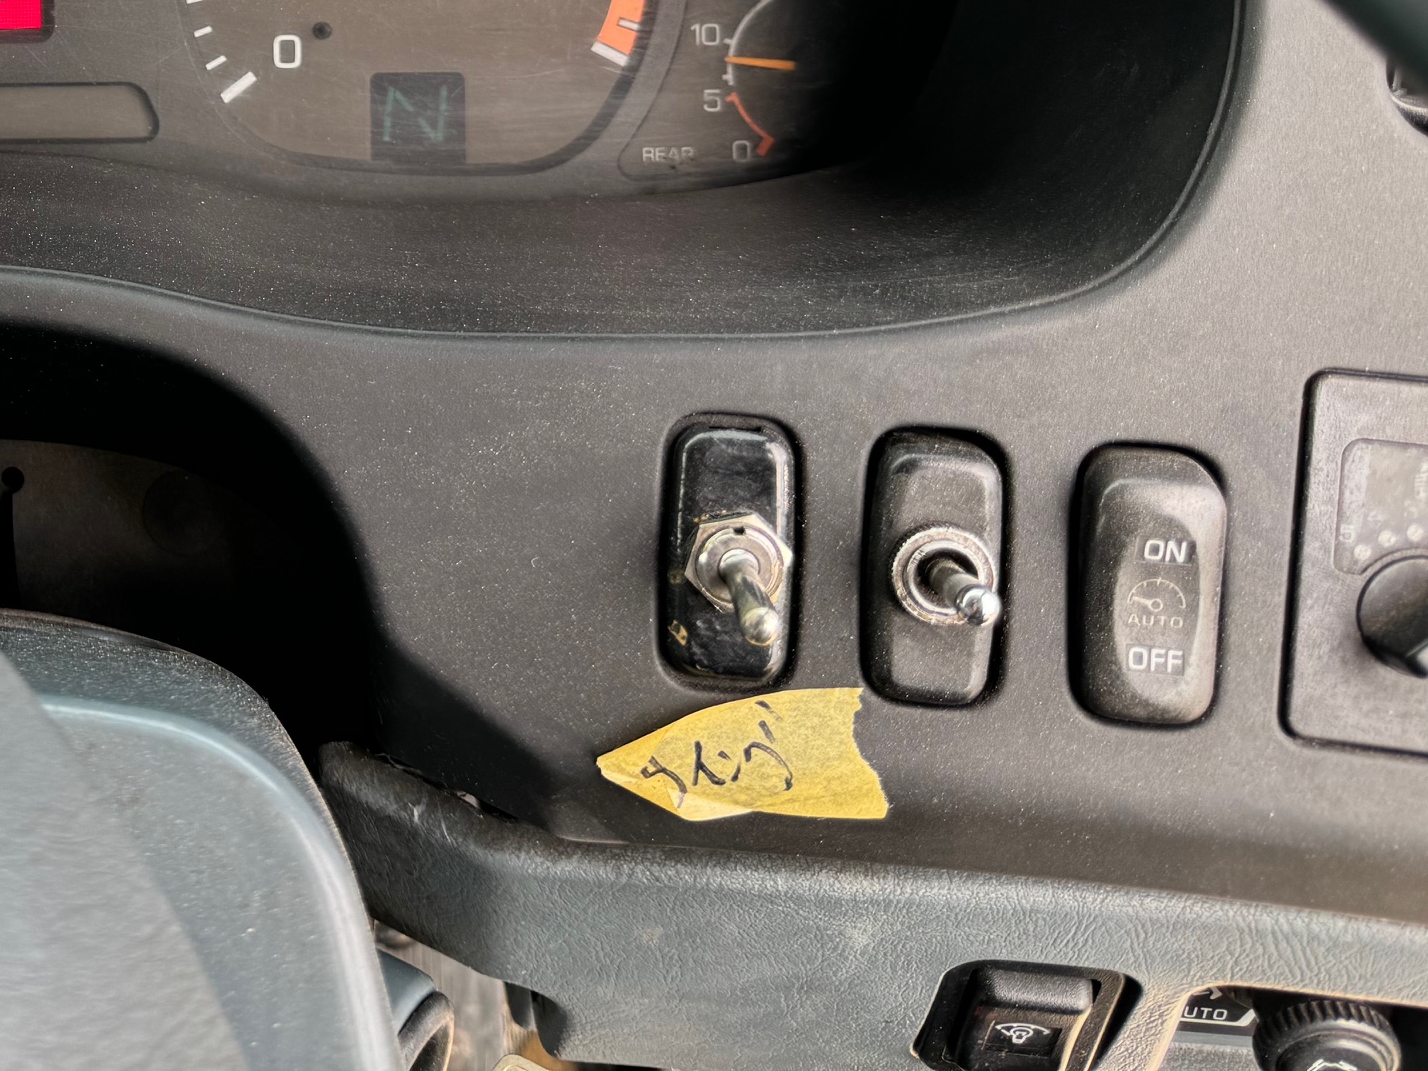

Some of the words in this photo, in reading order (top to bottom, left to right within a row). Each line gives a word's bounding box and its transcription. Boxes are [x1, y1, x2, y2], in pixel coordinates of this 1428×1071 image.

[691, 24, 722, 46] 10
[273, 34, 303, 69] 0
[703, 91, 722, 112] 5
[382, 85, 449, 144] N
[732, 140, 751, 163] 0
[1143, 539, 1188, 563] ON
[1128, 613, 1184, 629] AUTO
[1128, 646, 1184, 673] OFF
[1182, 1006, 1228, 1021] UTO
